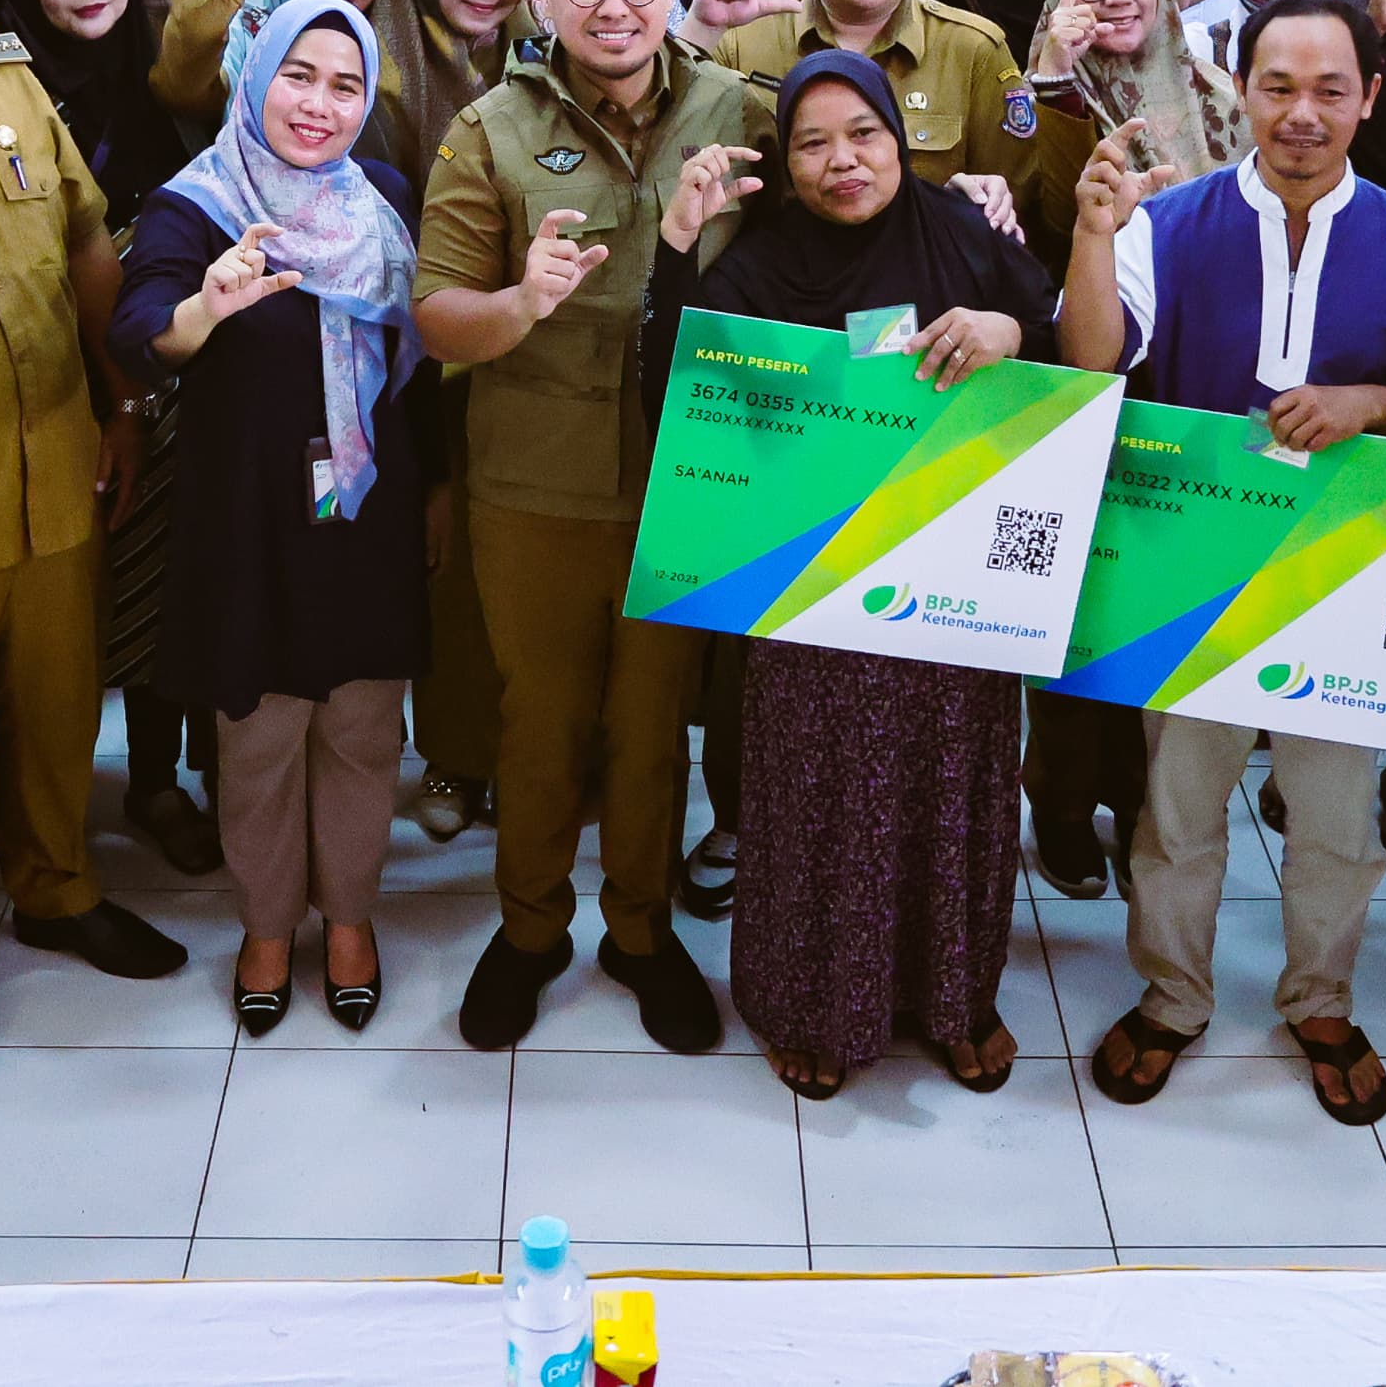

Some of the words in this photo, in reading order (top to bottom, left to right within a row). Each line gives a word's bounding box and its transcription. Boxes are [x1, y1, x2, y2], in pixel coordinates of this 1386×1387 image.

[696, 348, 743, 365] KARTU
[747, 357, 810, 375] PESERTA
[690, 382, 739, 403] 3674
[745, 391, 795, 412] 0355
[800, 400, 857, 422] XXXX
[862, 410, 917, 431] XXXX
[1120, 436, 1182, 455] PESERTA
[674, 464, 750, 487] SA'ANAH
[1121, 470, 1171, 491] 0322
[1177, 478, 1233, 501] XXXX
[1240, 488, 1297, 511] XXXX
[1092, 546, 1119, 561] ARI
[654, 569, 699, 585] 12-2023
[925, 594, 978, 615] BPJS
[921, 612, 1047, 639] Ketenagakerjaan
[1323, 674, 1378, 696] BPJS
